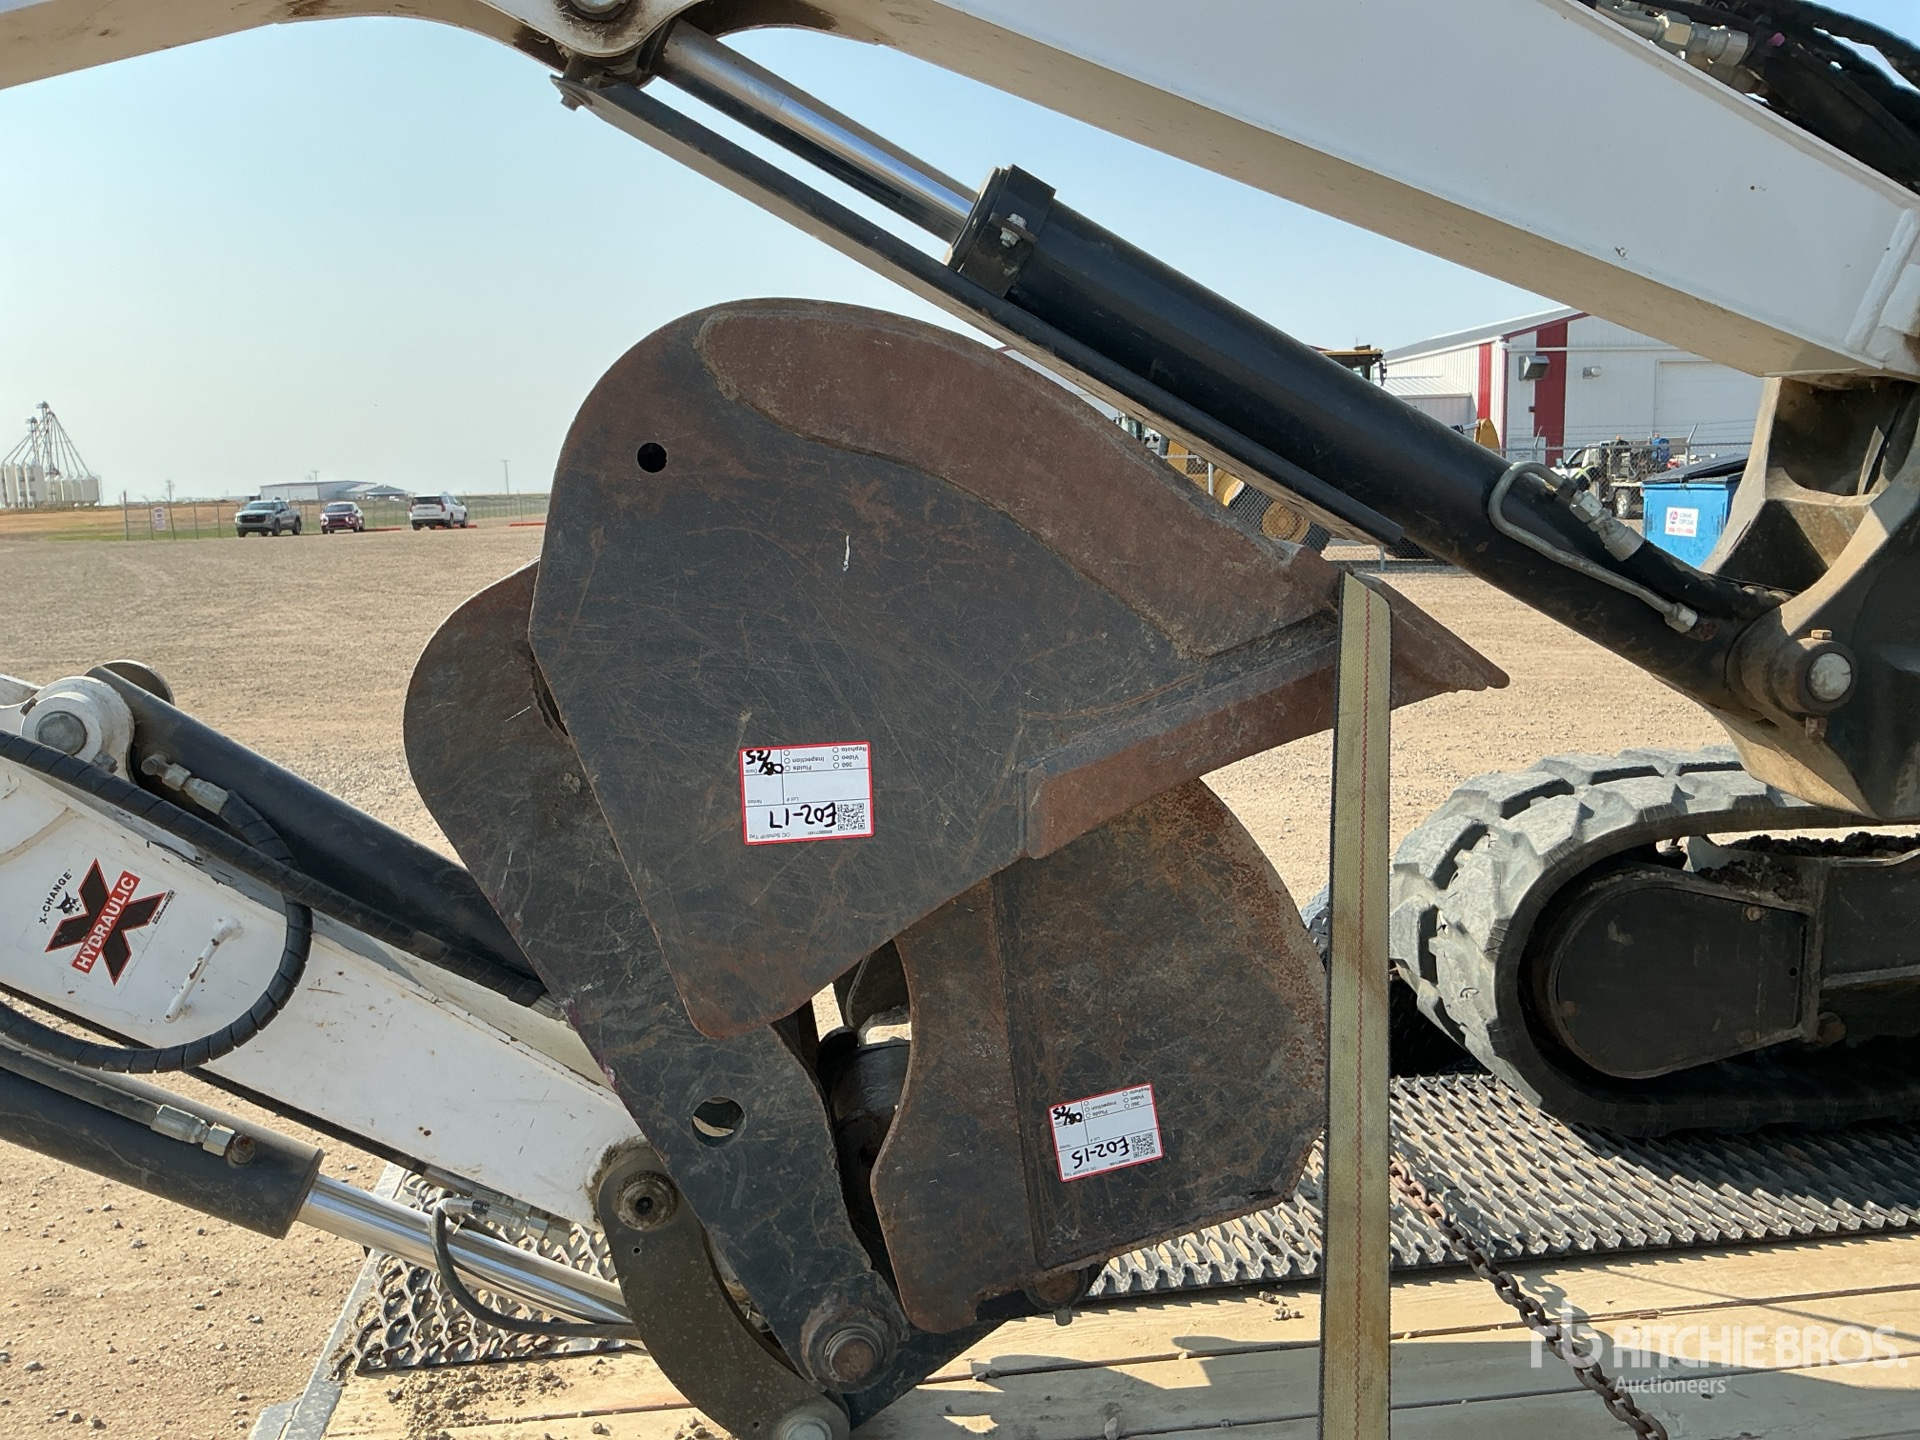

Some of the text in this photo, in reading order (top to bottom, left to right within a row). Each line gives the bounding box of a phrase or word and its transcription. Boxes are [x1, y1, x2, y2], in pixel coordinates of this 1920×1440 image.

[769, 802, 837, 828] E02-17
[76, 876, 135, 969] HYDRAULIC
[1071, 1136, 1129, 1169] E02-15
